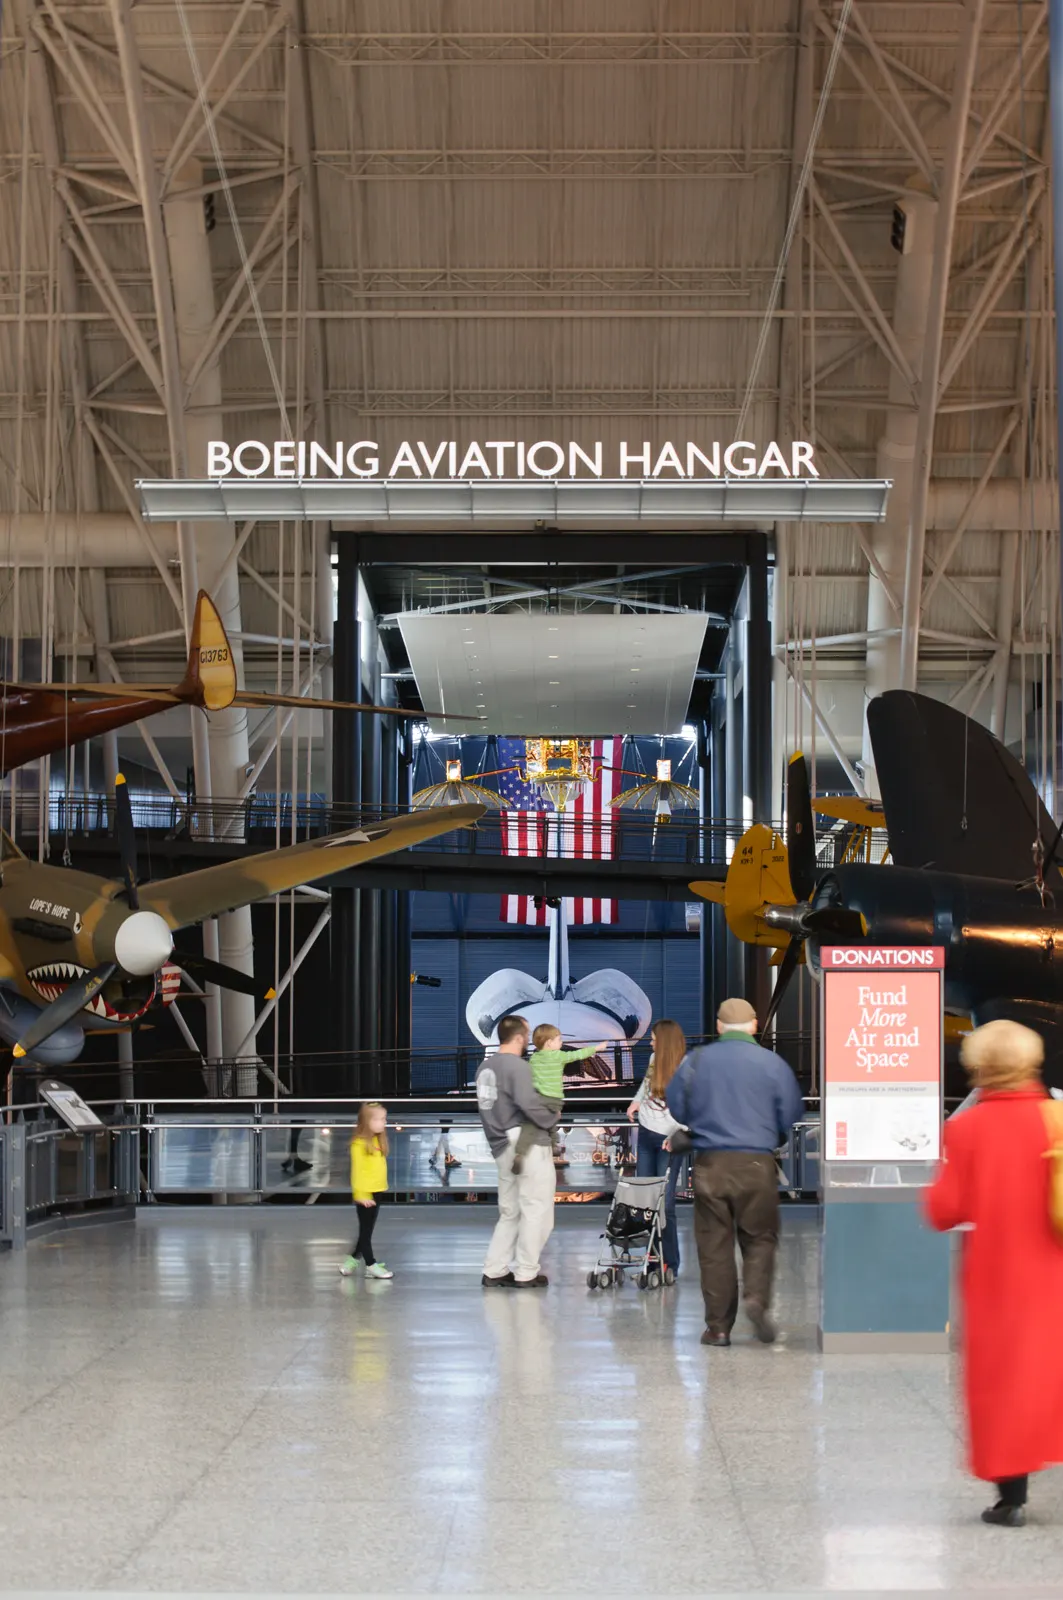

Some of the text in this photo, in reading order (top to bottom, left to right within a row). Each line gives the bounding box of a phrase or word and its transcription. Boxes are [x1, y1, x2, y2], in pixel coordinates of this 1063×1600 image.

[207, 440, 820, 477] BOEING AVIATION HANGAR
[741, 846, 753, 856] 44
[29, 898, 70, 920] LOPE'S HOPE
[832, 950, 934, 965] DONATIONS
[858, 985, 907, 1006] Fund
[858, 1008, 907, 1027] More
[845, 1027, 919, 1047] Air and
[856, 1048, 909, 1073] Space
[573, 1151, 608, 1162] SPACE
[611, 1151, 638, 1162] HAN
